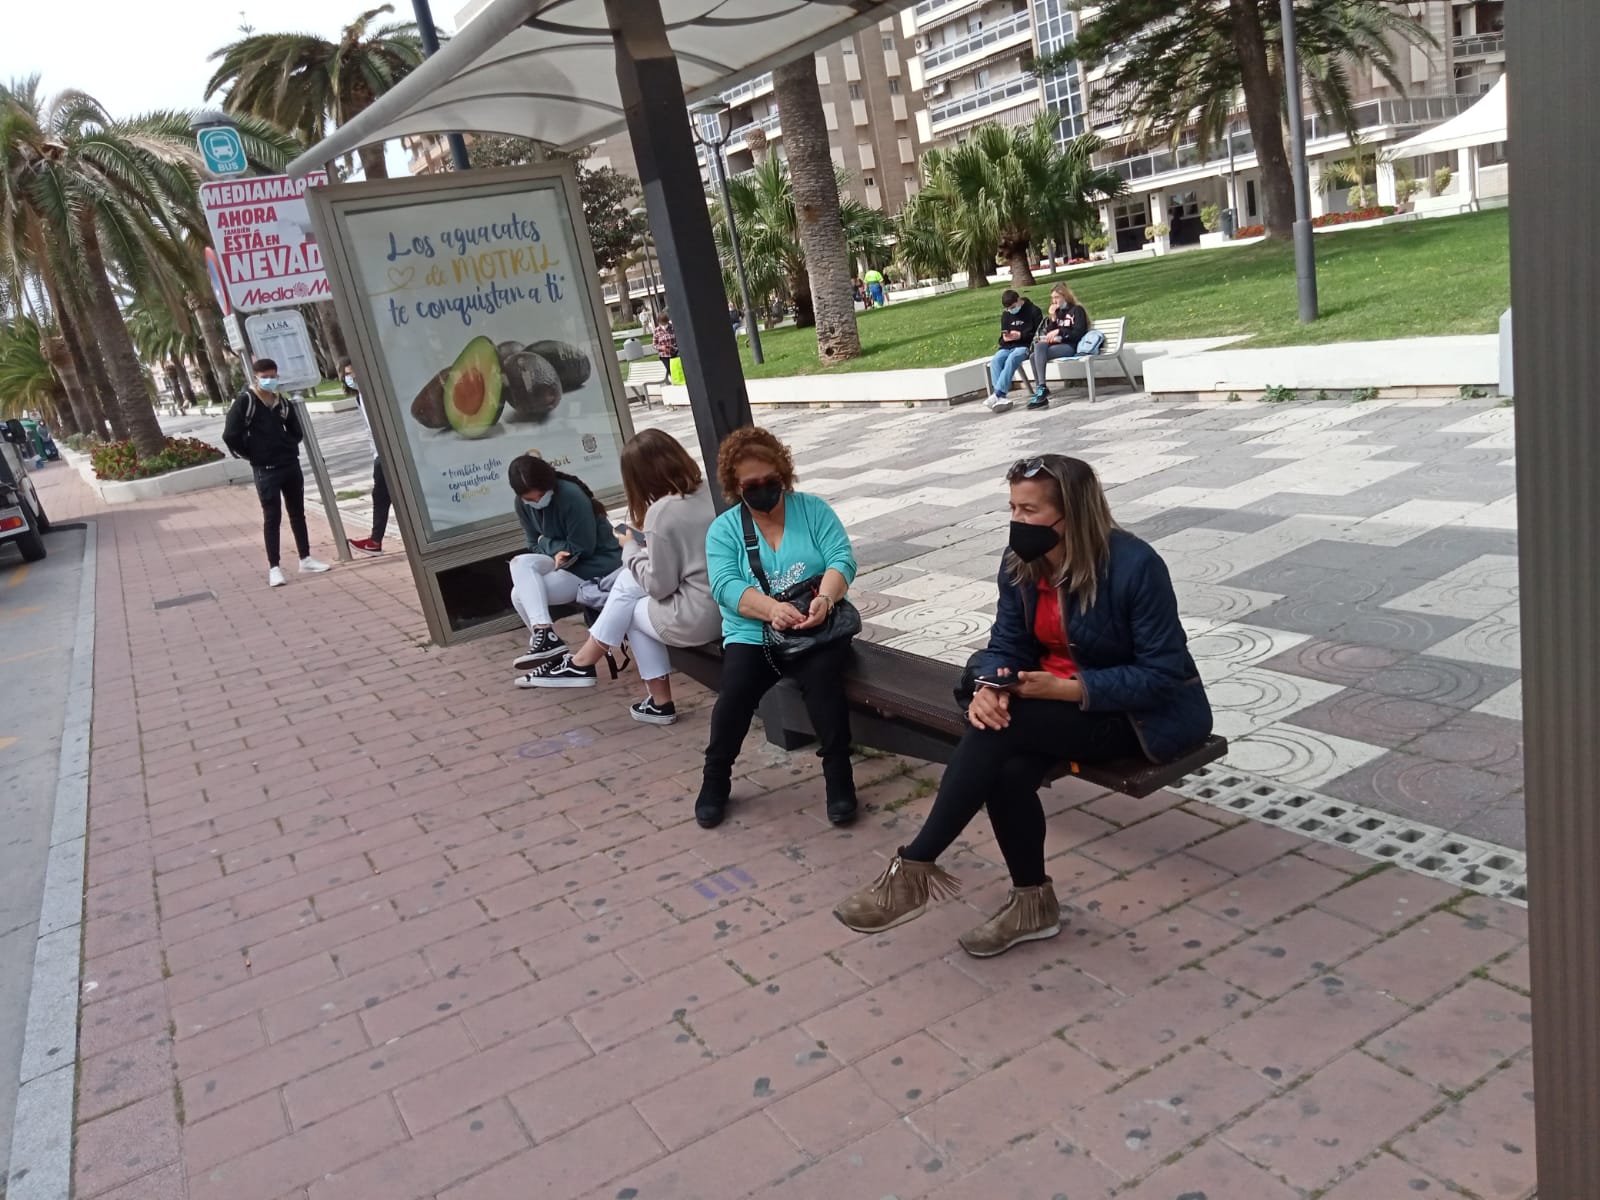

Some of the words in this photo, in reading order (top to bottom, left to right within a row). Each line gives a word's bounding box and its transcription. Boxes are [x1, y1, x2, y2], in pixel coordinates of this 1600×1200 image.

[217, 161, 239, 172] BUS
[217, 206, 278, 229] AHORA
[223, 229, 265, 252] ESTÁ
[265, 234, 280, 246] EN
[386, 231, 436, 262] Los
[440, 212, 541, 256] aguacates
[425, 264, 449, 287] de
[451, 243, 560, 286] MOTRIL
[240, 286, 294, 307] Media
[388, 296, 410, 327] te
[415, 280, 524, 326] conquistan
[528, 287, 542, 304] a
[266, 320, 289, 332] ALSA
